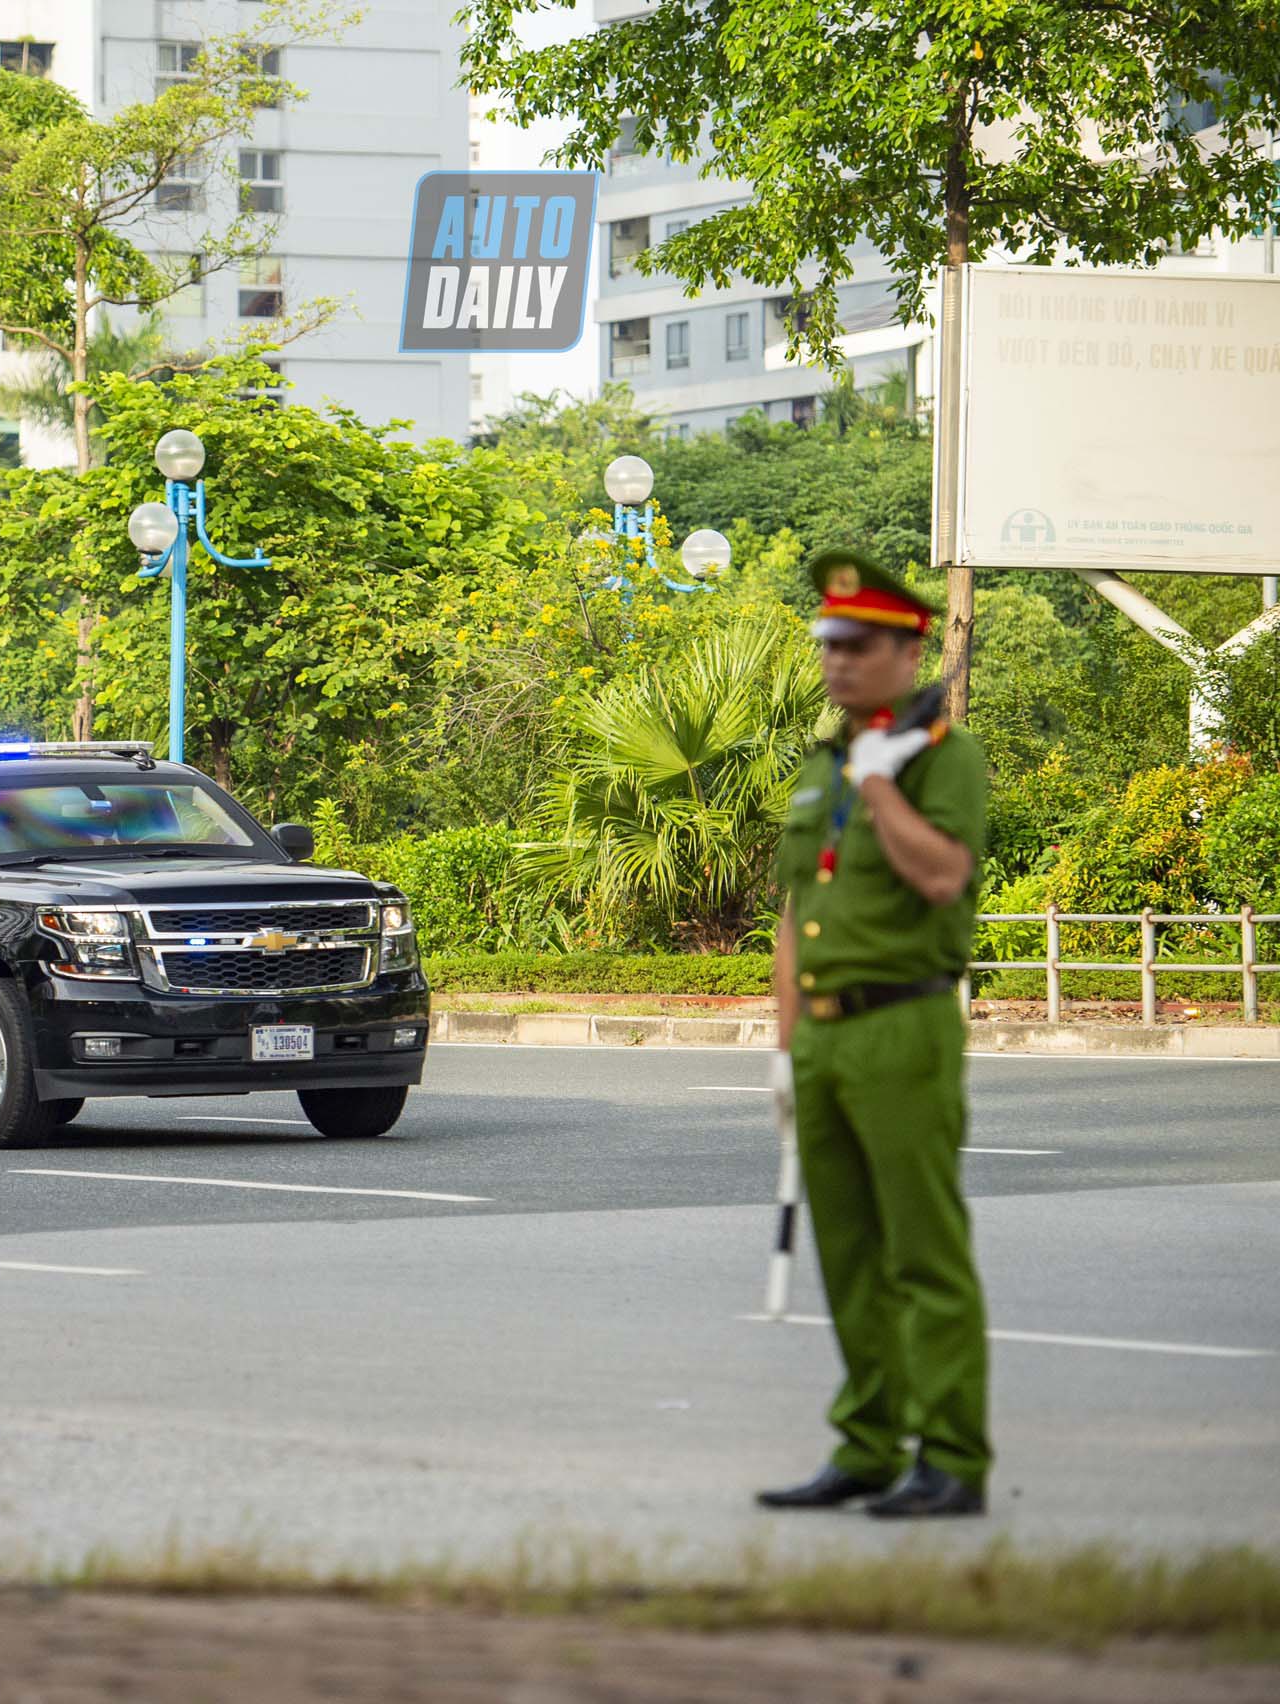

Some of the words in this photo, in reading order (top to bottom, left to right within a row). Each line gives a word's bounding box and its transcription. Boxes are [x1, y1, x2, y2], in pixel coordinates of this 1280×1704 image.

[1041, 291, 1105, 322] KHÔNG
[1150, 343, 1202, 375] CHẠY
[1210, 344, 1237, 371] XE
